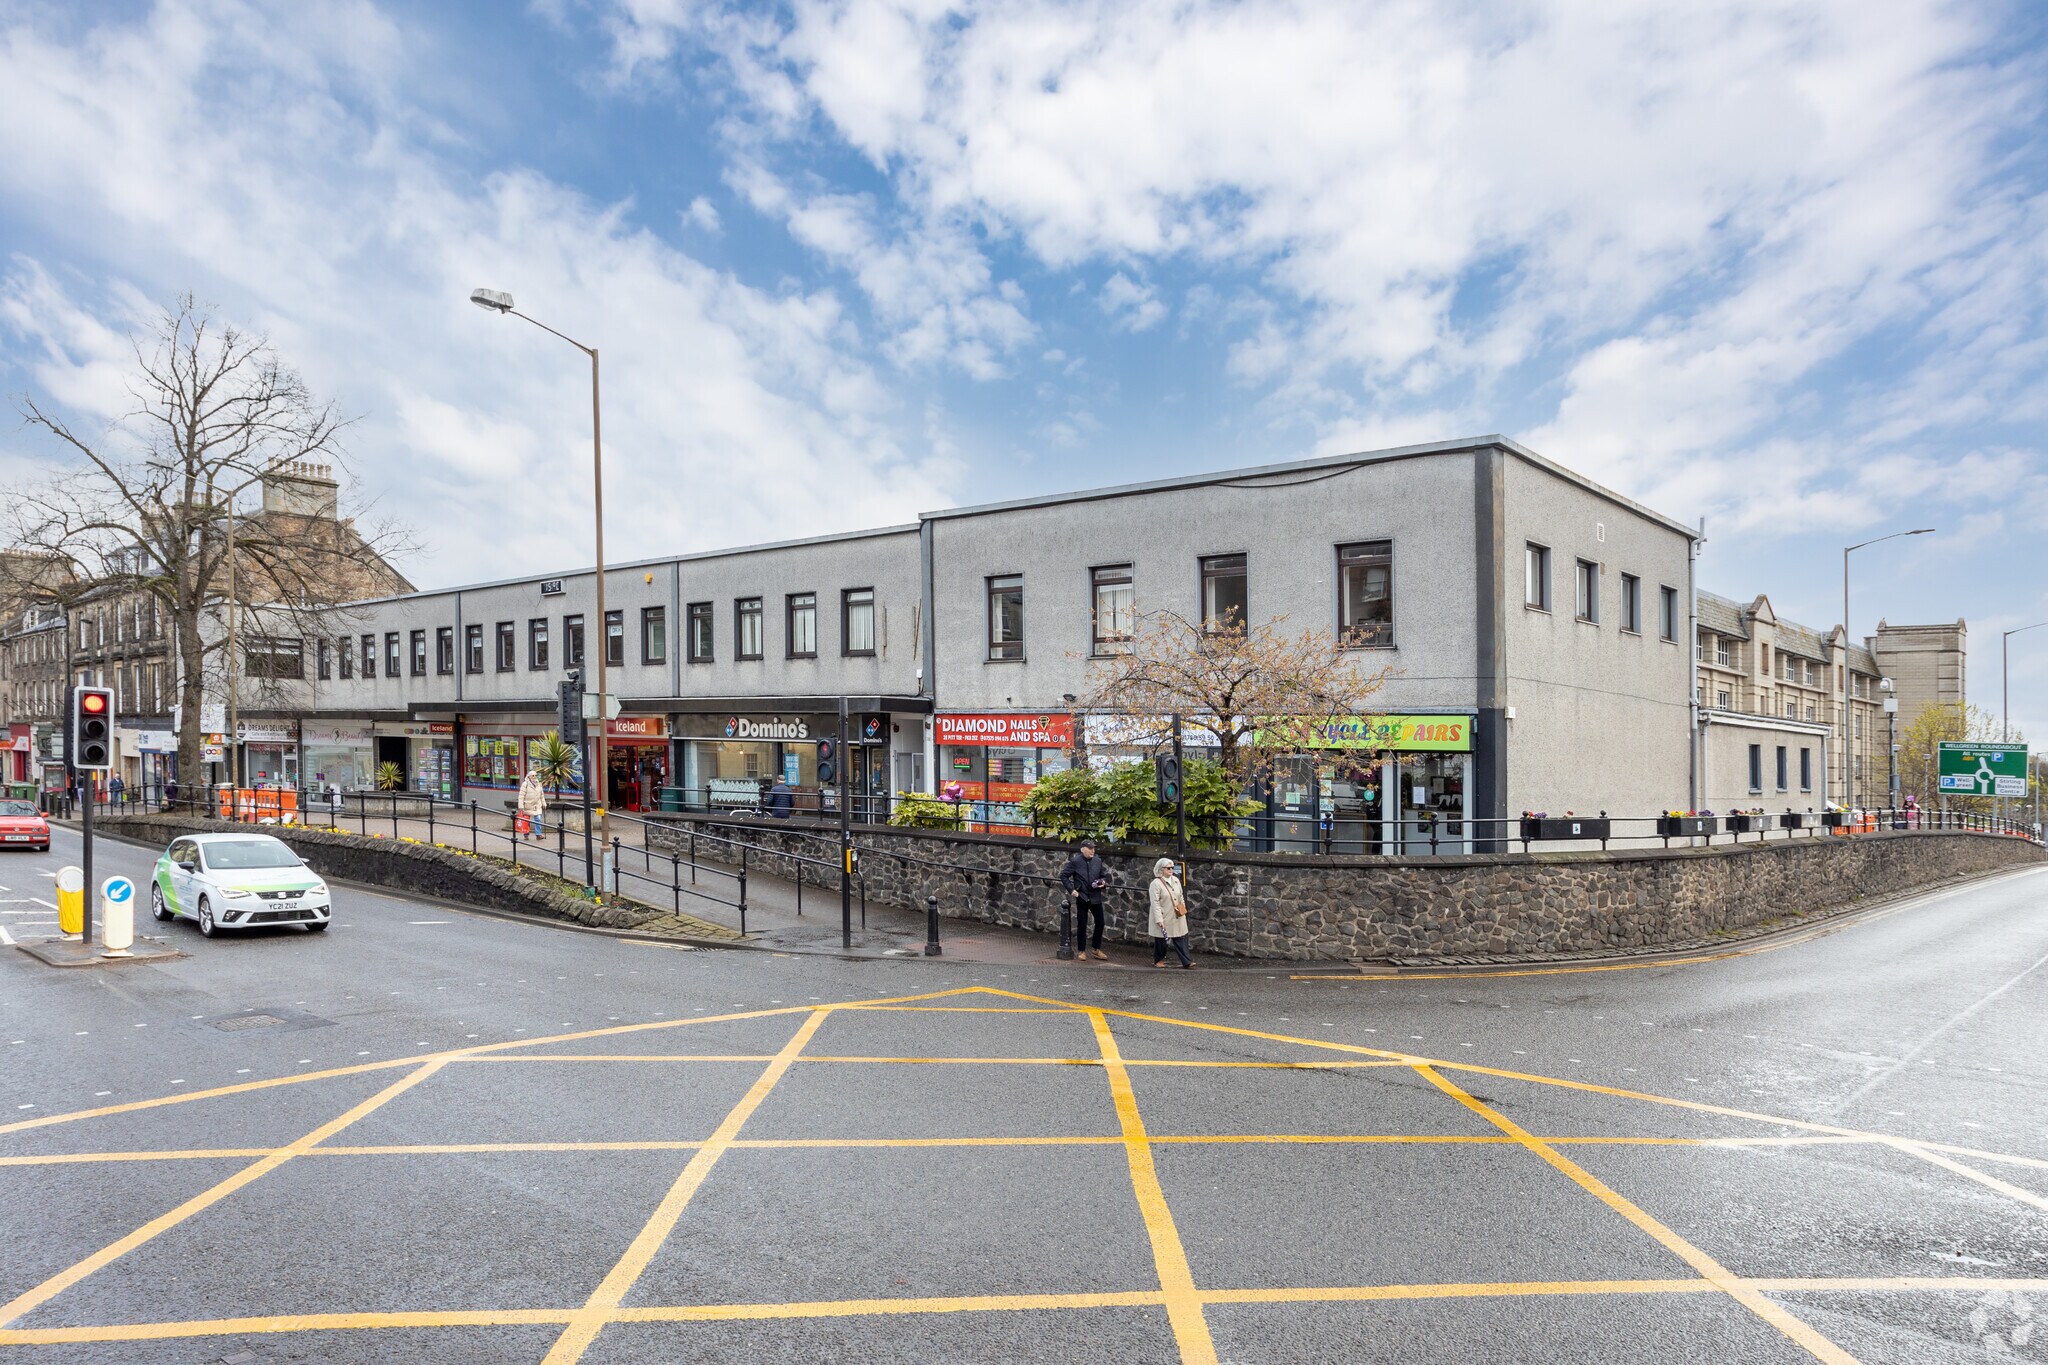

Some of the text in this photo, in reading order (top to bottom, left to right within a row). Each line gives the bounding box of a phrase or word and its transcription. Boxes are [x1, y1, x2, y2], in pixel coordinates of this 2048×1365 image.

[615, 720, 646, 732] Iceland
[738, 717, 808, 739] Domino's
[942, 718, 1037, 733] DIAMOND NAILS
[1010, 731, 1051, 743] AND SPA
[1317, 722, 1372, 744] CYCLE
[1376, 722, 1463, 743] REPAIRS
[269, 902, 284, 910] YC21
